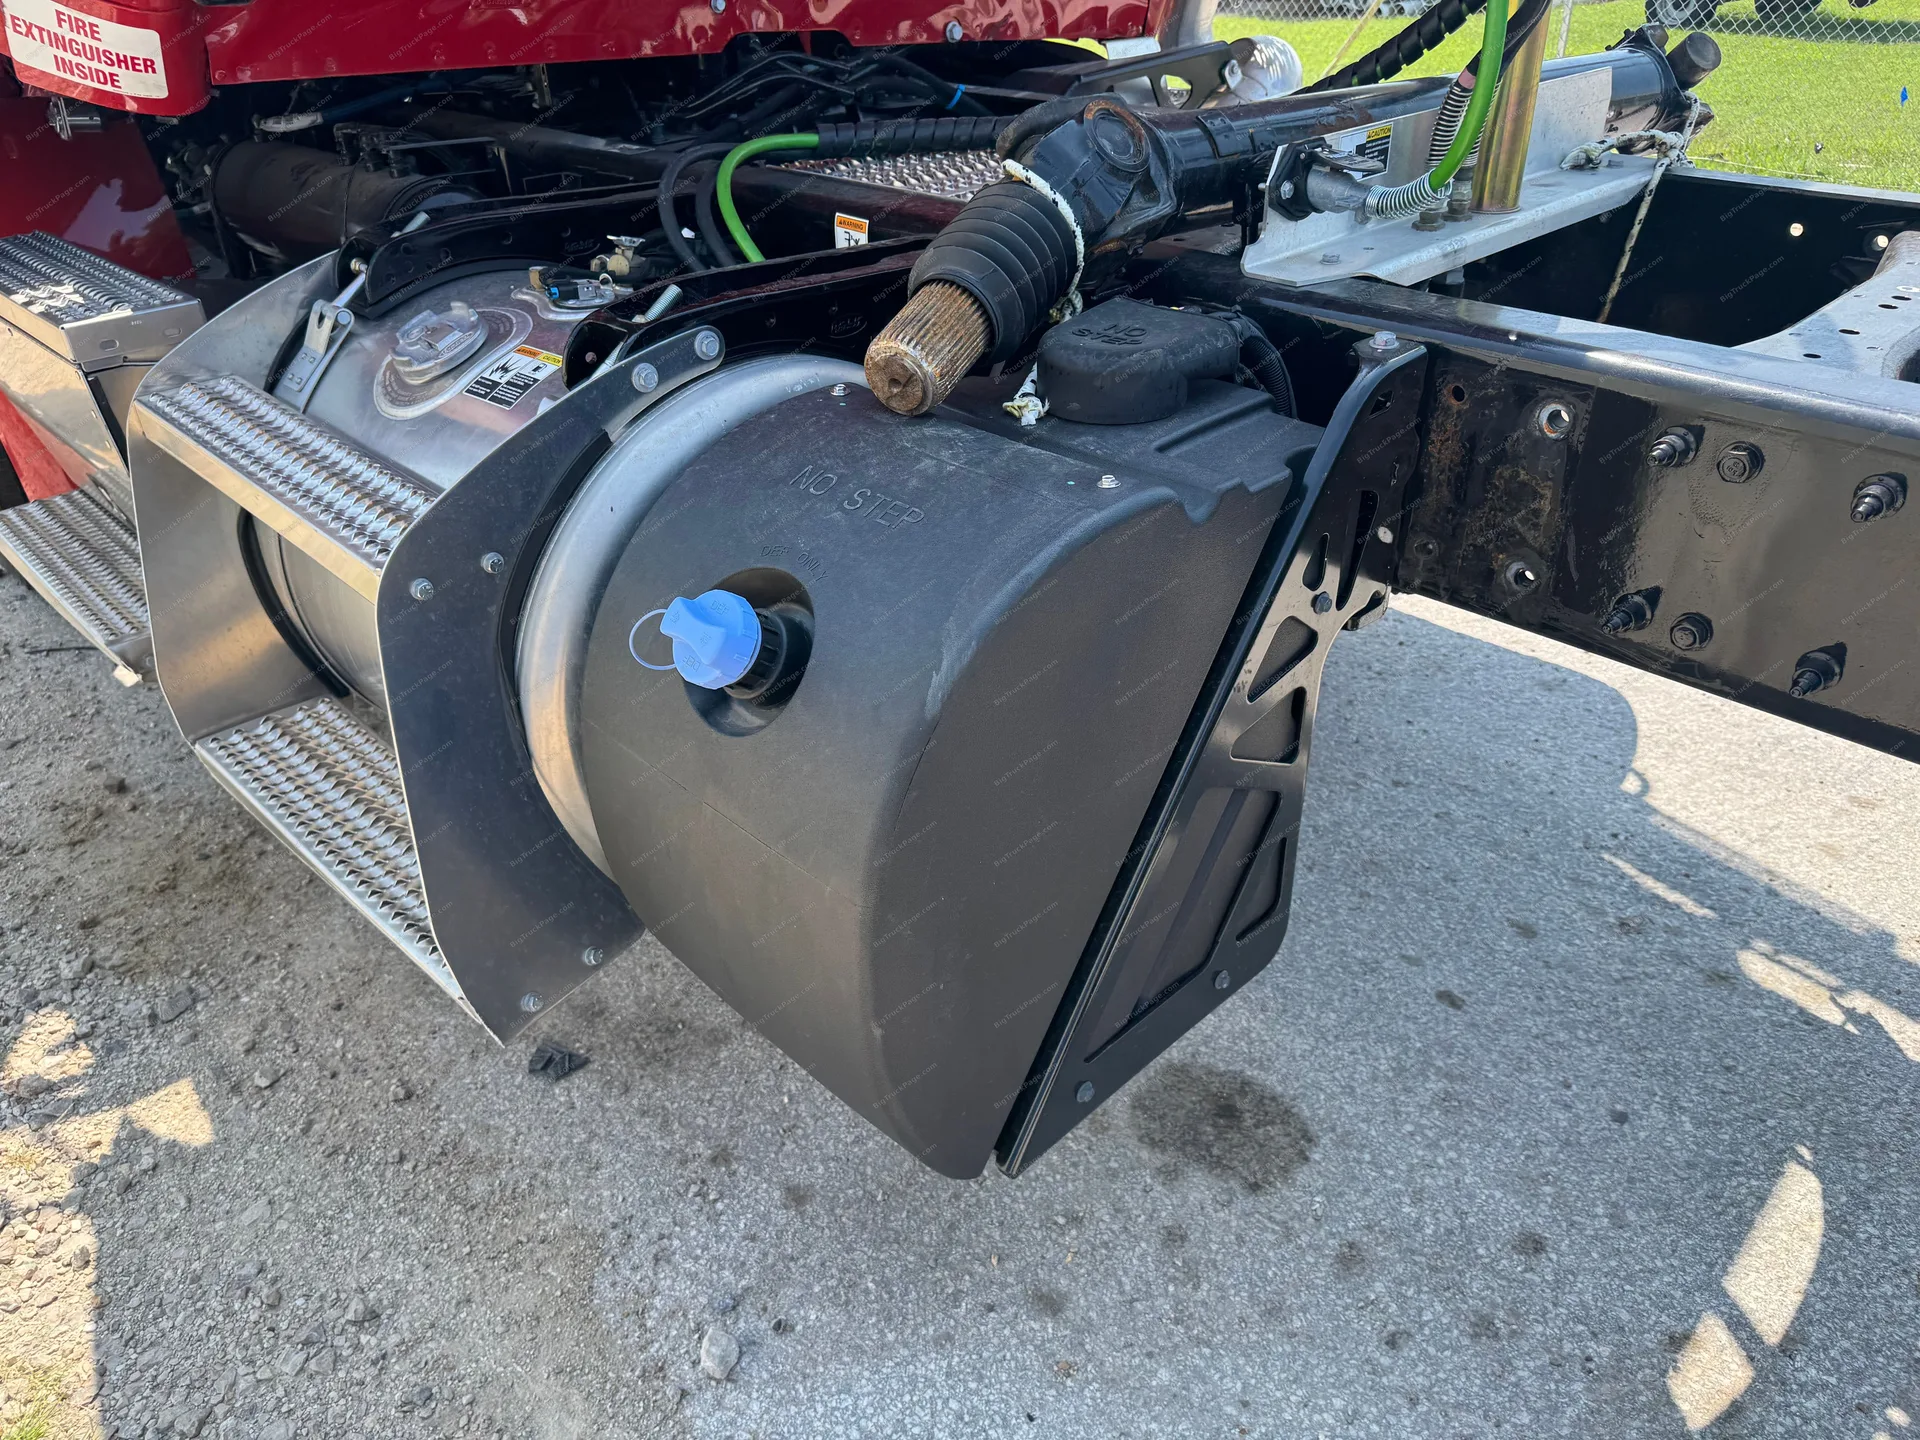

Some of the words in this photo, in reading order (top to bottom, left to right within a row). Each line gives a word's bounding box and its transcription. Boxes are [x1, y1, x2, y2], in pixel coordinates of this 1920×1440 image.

[55, 9, 102, 42] FIRE
[10, 14, 156, 74] EXTINGUISHER
[53, 55, 122, 89] INSIDE
[1371, 127, 1391, 139] CAUTION
[842, 220, 864, 230] WARNING
[1072, 328, 1143, 345] STEP
[1104, 323, 1147, 337] NO
[789, 464, 838, 496] NO
[843, 488, 925, 530] STEP
[760, 545, 792, 558] DEF
[798, 551, 828, 584] ONLY
[710, 600, 729, 615] DEF
